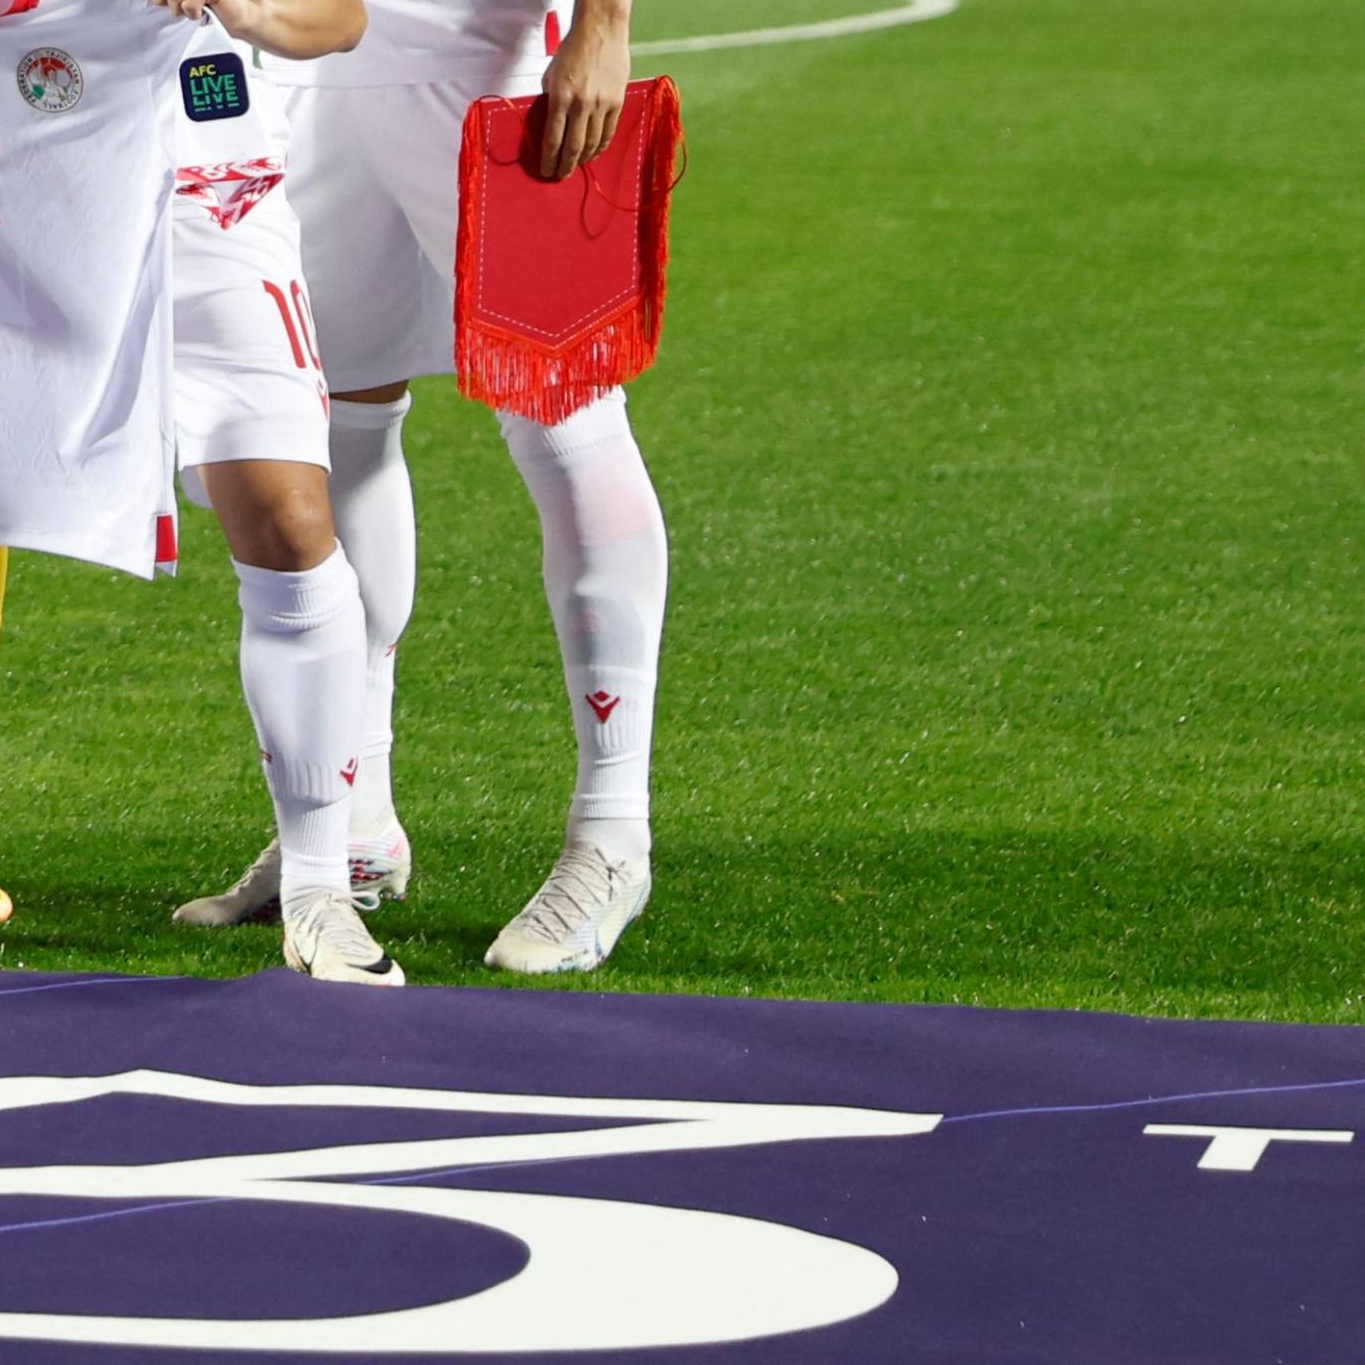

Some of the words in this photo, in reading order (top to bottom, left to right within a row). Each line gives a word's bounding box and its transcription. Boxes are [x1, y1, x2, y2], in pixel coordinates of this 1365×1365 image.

[189, 64, 217, 78] AFC
[190, 74, 237, 95] LIVE
[193, 91, 239, 106] LIVE
[261, 279, 321, 371] 10
